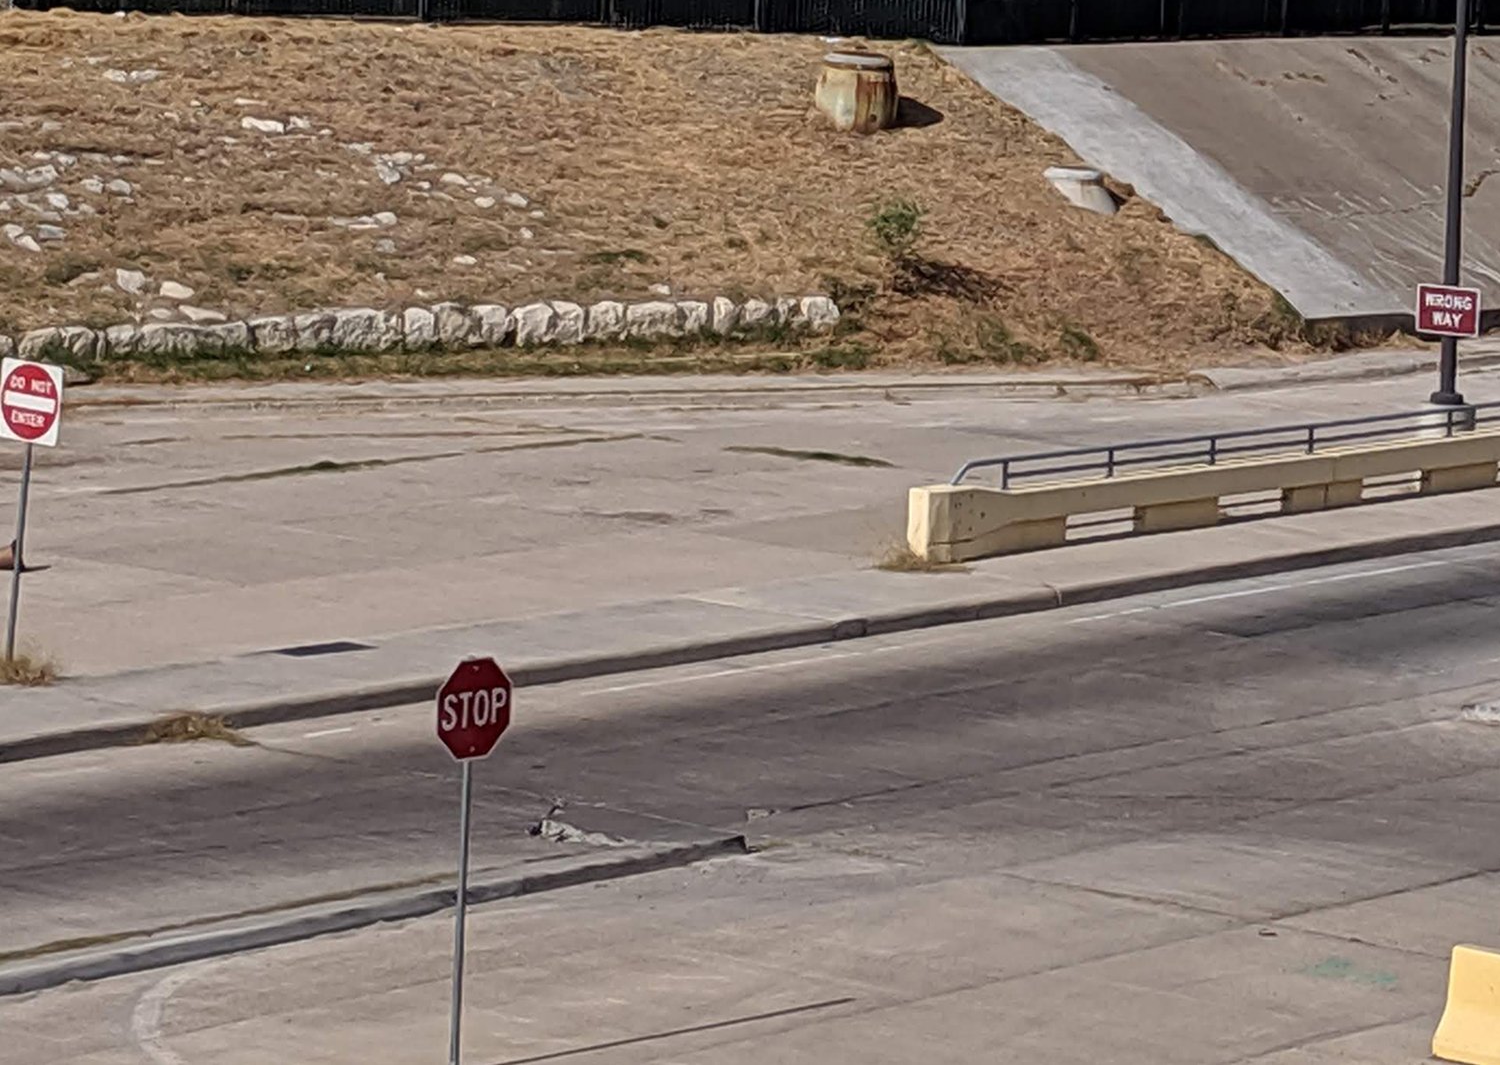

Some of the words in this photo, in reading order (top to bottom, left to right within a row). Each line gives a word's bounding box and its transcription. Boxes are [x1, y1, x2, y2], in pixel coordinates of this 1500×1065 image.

[1425, 293, 1472, 310] WRONG
[1432, 311, 1463, 329] WAY
[9, 375, 26, 389] DO
[31, 379, 52, 394] NOT
[441, 687, 507, 731] STOP
